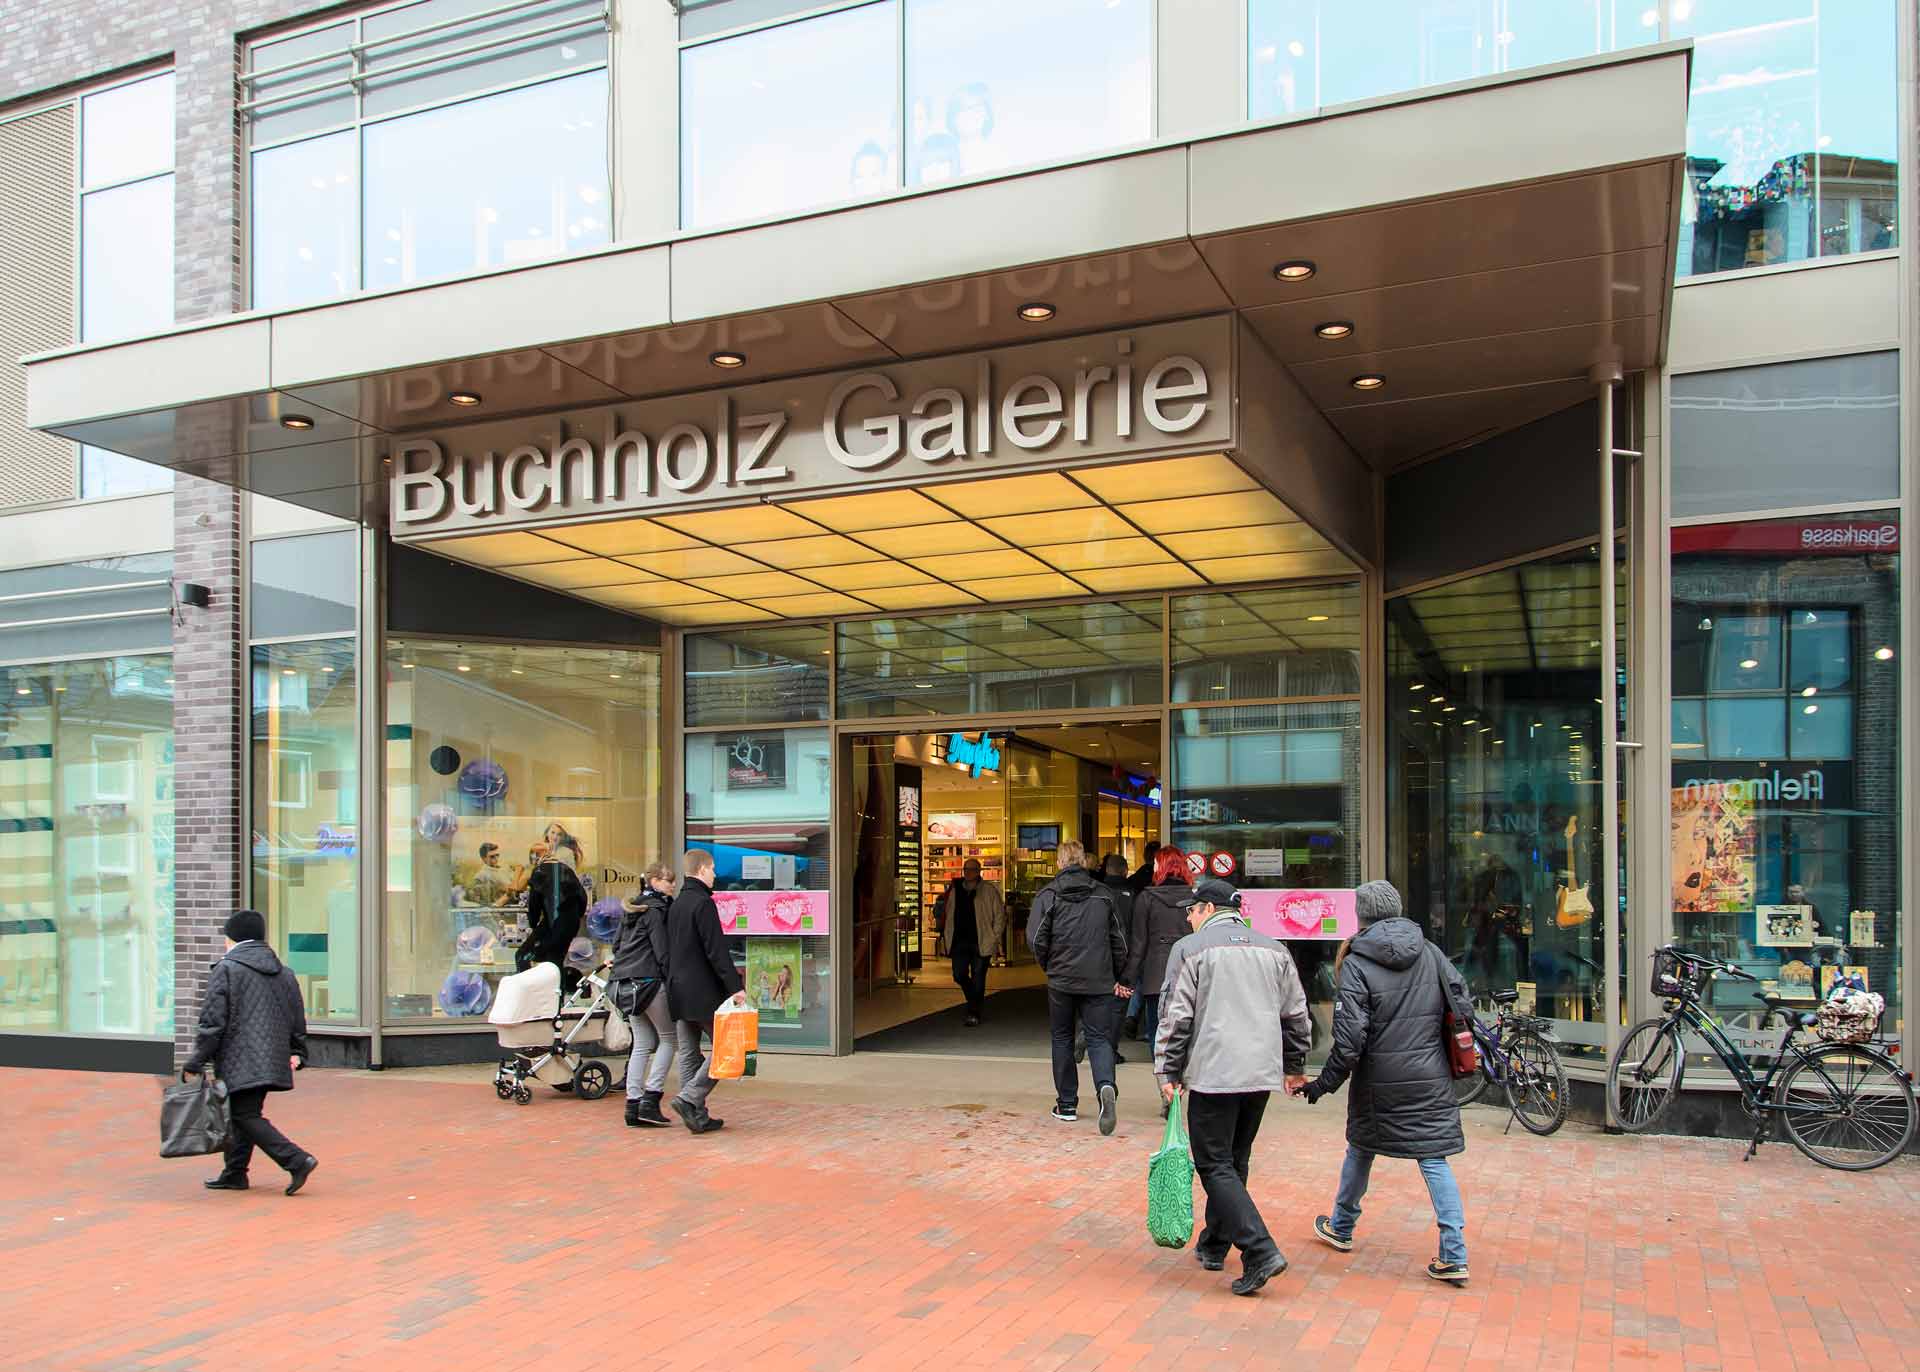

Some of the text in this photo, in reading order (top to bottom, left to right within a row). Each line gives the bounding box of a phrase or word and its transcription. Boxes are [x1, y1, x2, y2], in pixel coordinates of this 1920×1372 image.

[393, 336, 1209, 524] Buchholz Galerie
[602, 868, 636, 884] Dior
